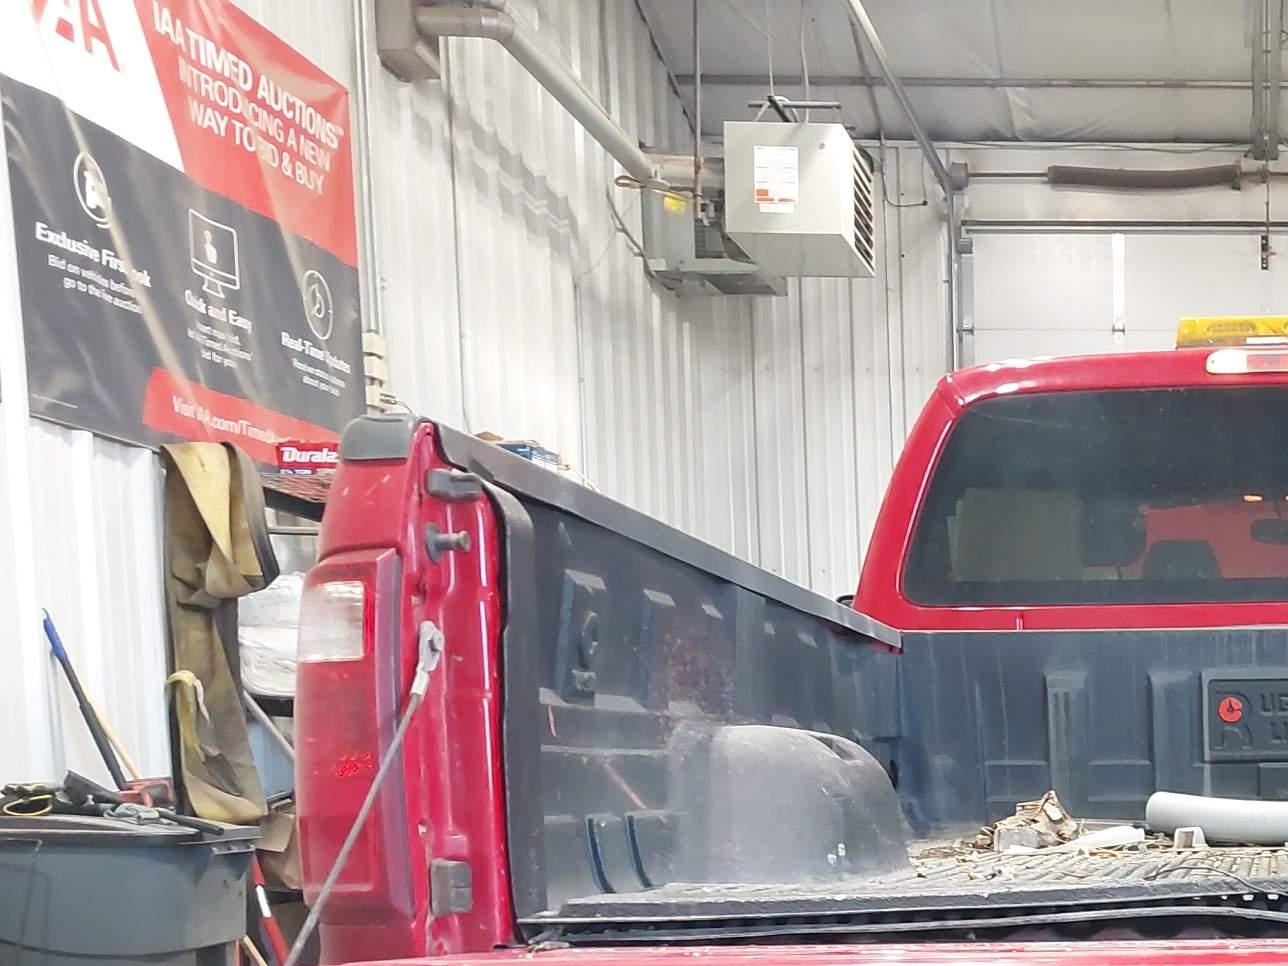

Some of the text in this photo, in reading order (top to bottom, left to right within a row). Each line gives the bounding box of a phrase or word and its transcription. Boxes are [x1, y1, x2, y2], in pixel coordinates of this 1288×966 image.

[153, 0, 187, 52] IAA
[186, 27, 253, 91] TIMED
[189, 95, 228, 137] WAY
[231, 120, 257, 152] TO
[282, 152, 293, 178] &
[295, 161, 325, 194] BUY
[287, 128, 297, 150] A
[300, 135, 330, 172] NEW
[35, 221, 100, 262] Exclusive
